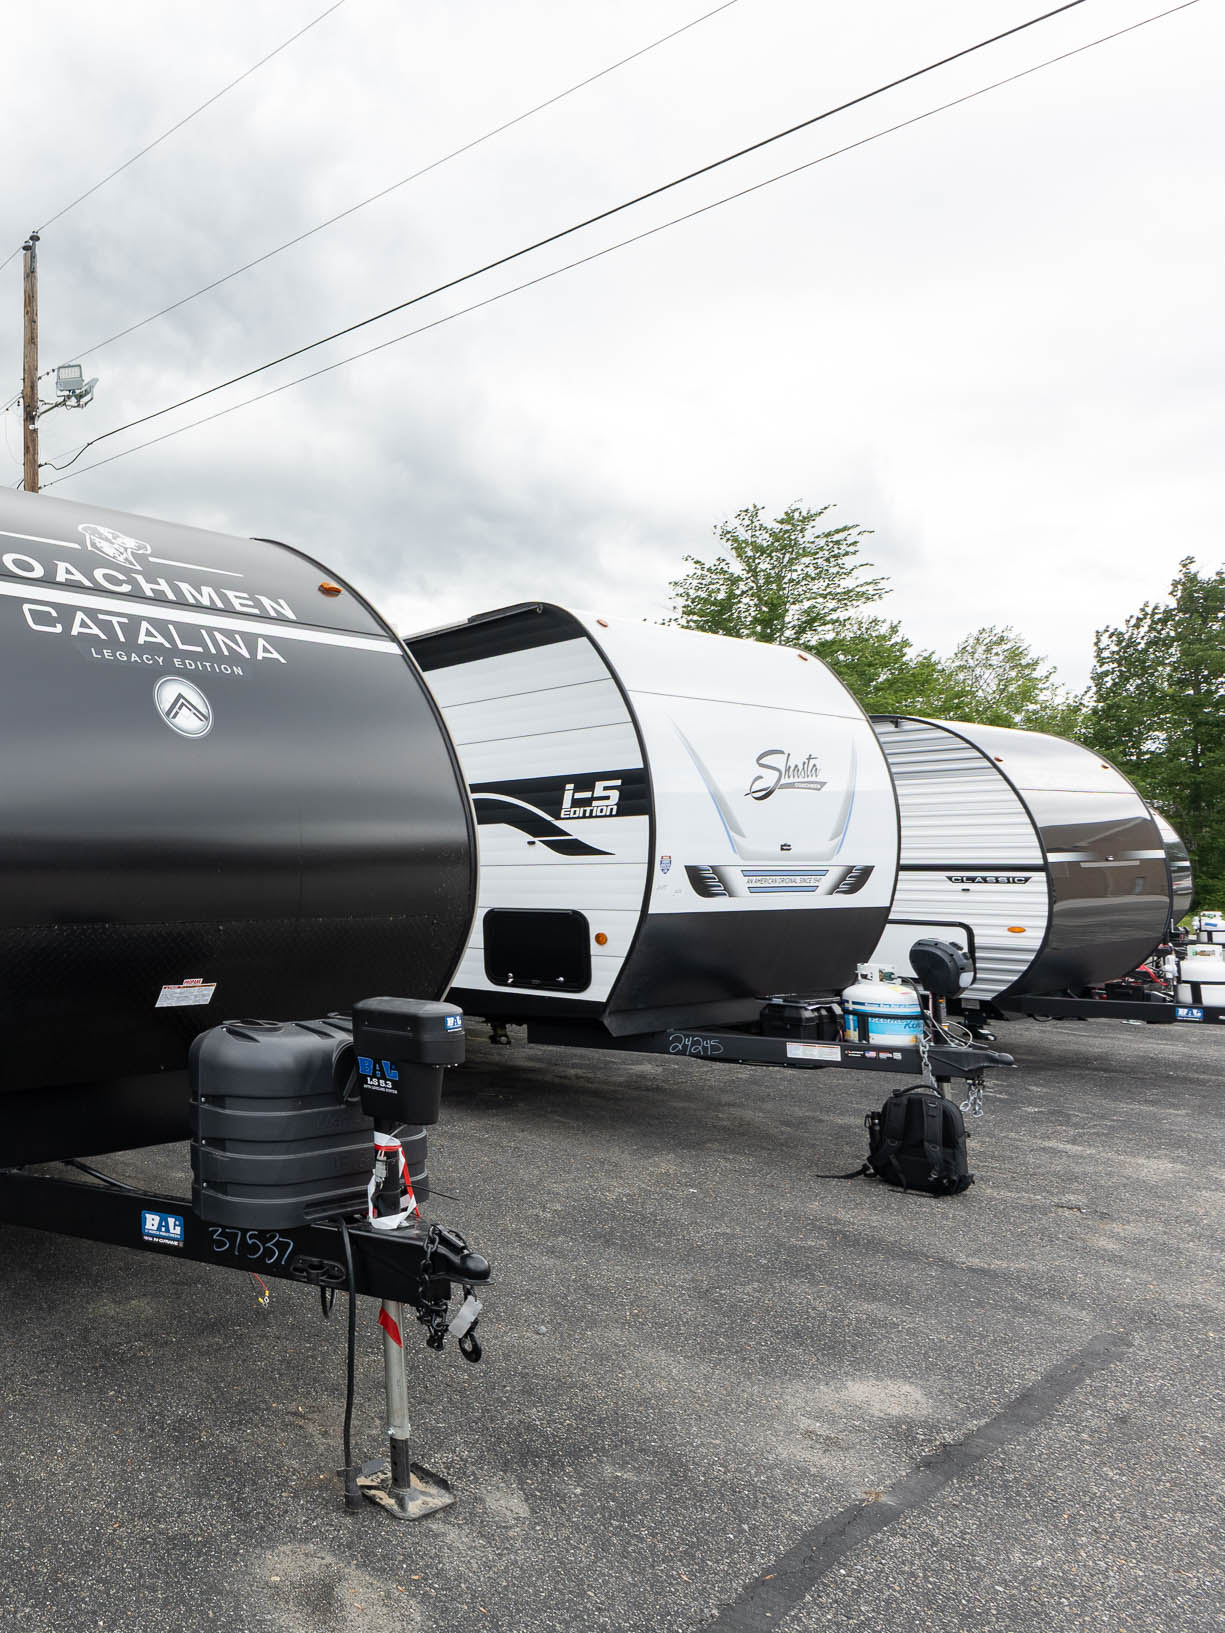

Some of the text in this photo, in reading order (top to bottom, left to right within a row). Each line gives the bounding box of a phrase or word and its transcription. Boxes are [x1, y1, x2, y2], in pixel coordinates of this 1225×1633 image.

[22, 603, 287, 664] CATALINA
[91, 648, 244, 675] LEGACY EDITION
[744, 749, 820, 800] Shasta
[560, 805, 617, 818] EDITION
[951, 876, 1026, 884] CLASSIC
[669, 1034, 724, 1056] 24245
[367, 1077, 378, 1086] LS
[145, 1213, 181, 1235] BAL
[209, 1227, 294, 1264] 37537
